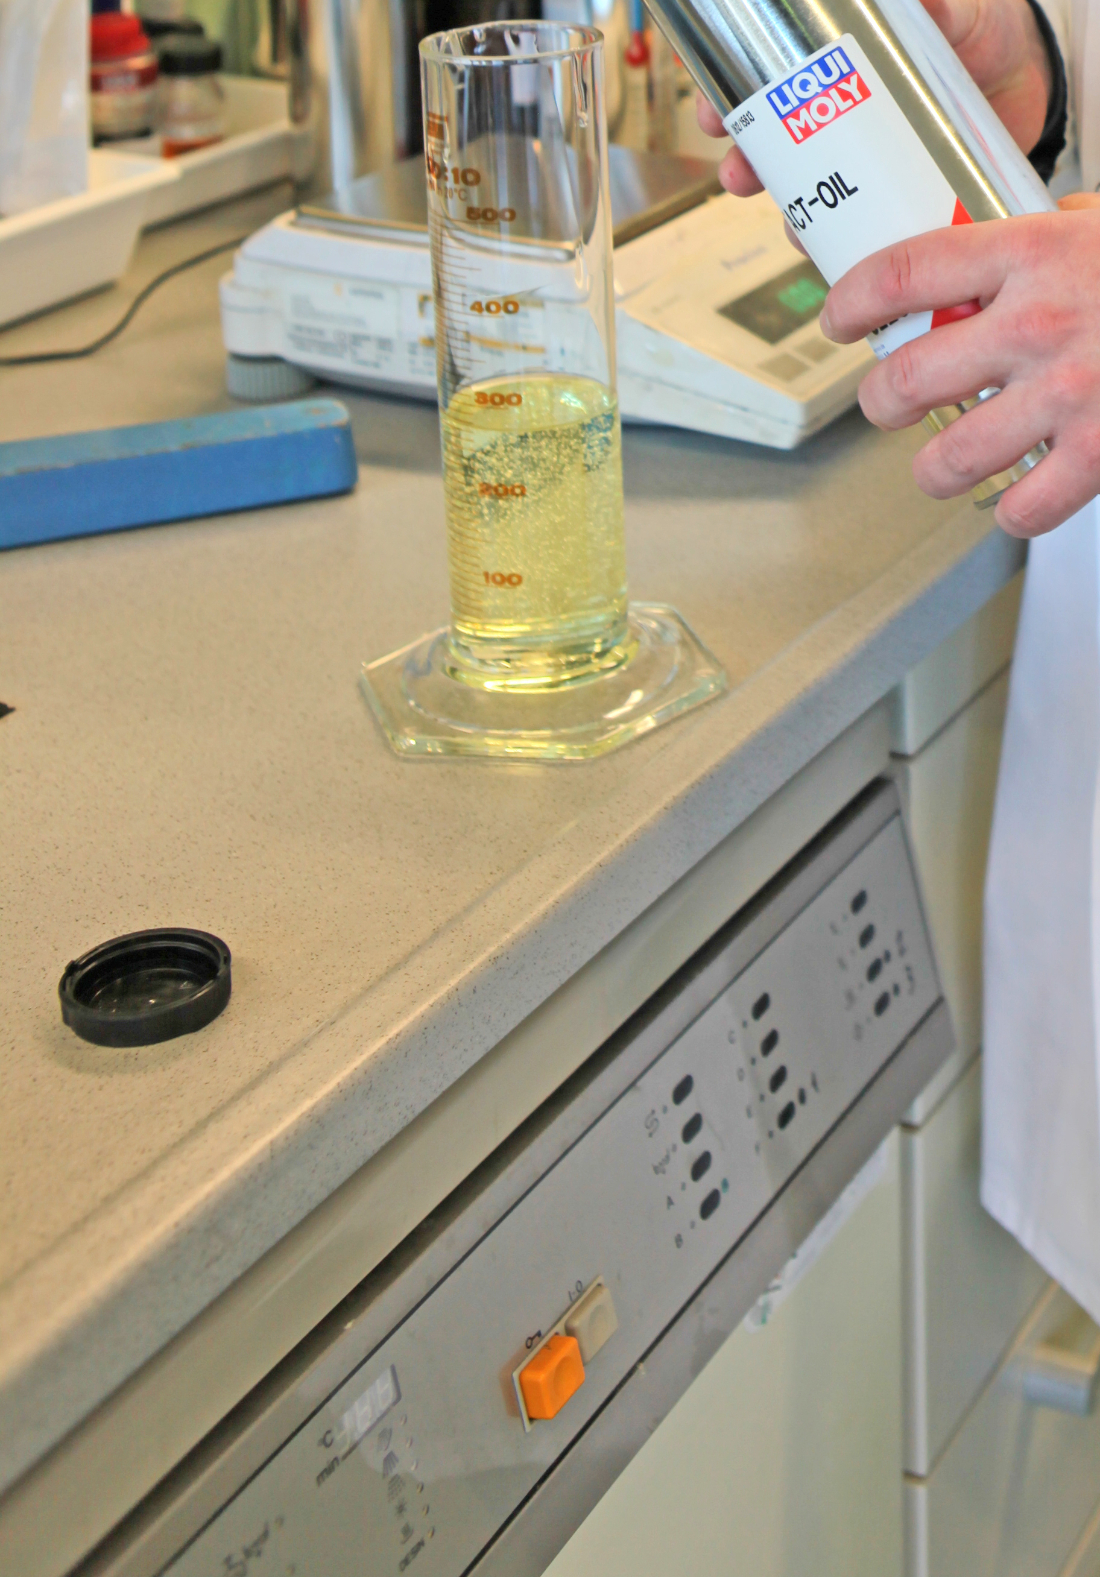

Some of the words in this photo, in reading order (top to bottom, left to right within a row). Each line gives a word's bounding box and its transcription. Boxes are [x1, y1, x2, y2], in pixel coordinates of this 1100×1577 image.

[769, 49, 851, 117] LIQUI
[785, 73, 864, 142] MOLY
[466, 207, 517, 222] 500
[469, 300, 520, 315] 400
[474, 391, 523, 407] 300
[478, 482, 527, 497] 200
[483, 571, 523, 587] 100
[315, 1456, 340, 1488] min
